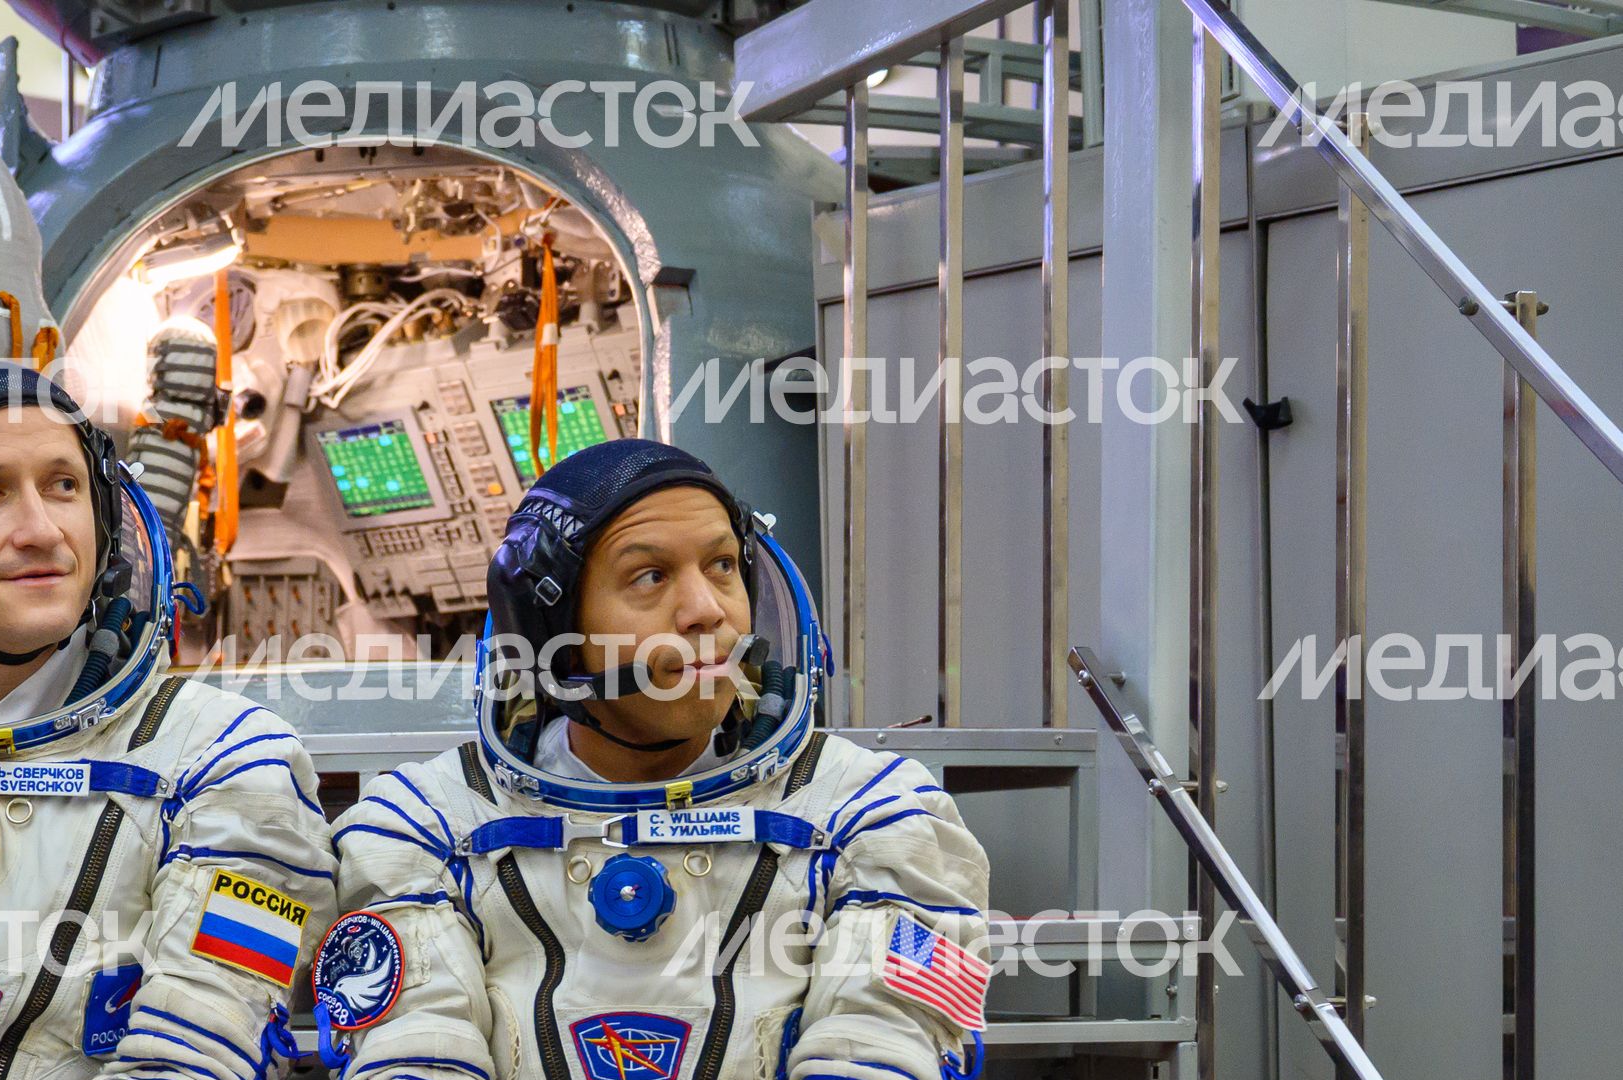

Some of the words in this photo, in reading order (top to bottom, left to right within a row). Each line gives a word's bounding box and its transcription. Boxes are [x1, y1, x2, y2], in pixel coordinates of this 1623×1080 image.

[669, 811, 741, 824] WILLIAMS
[214, 874, 307, 926] РОССИЯ
[333, 1001, 350, 1026] 28
